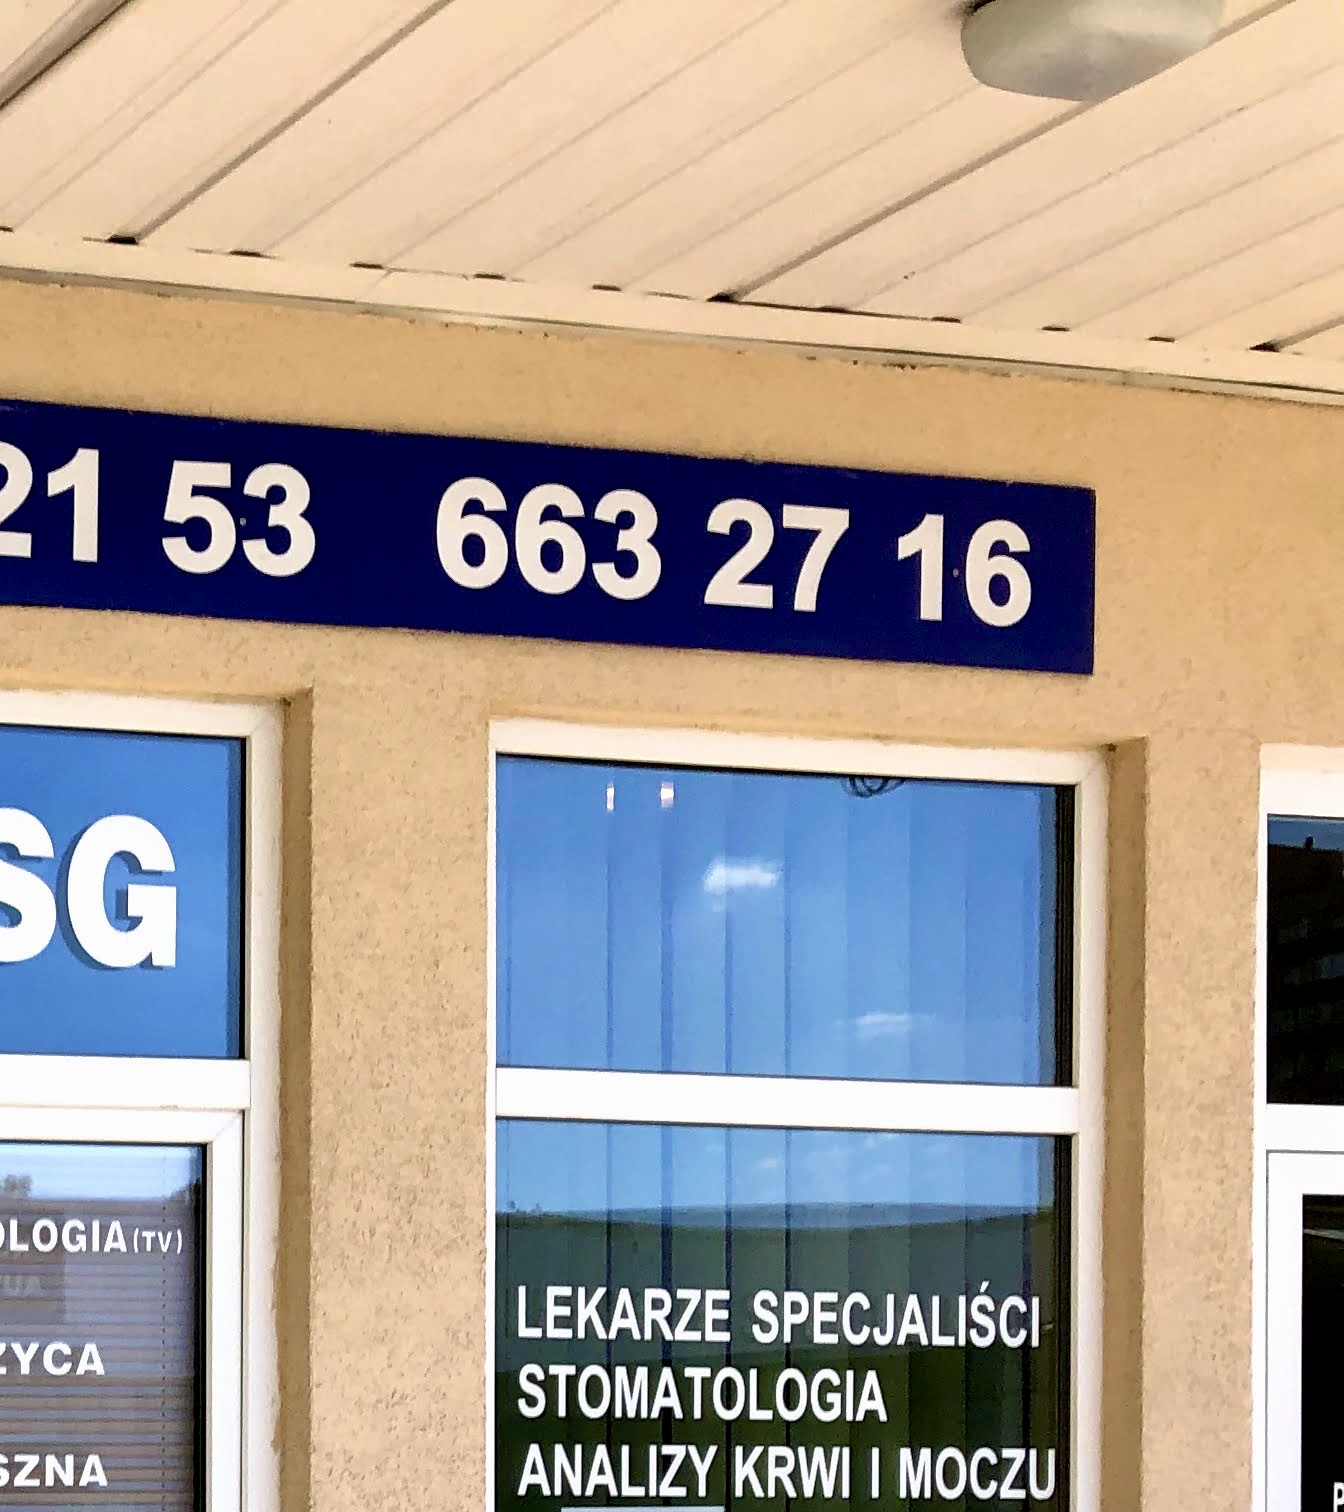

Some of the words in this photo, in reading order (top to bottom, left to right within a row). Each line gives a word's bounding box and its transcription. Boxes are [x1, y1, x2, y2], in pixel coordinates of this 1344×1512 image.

[162, 460, 315, 576] 53
[437, 477, 661, 600] 663
[704, 499, 849, 612] 27
[898, 514, 1031, 626] 16
[134, 1228, 182, 1254] (TV)
[518, 1286, 730, 1342] LEKARZE
[752, 1281, 1039, 1347] SPECJALIŚCI
[518, 1364, 887, 1422] STOMATOLOGIA
[518, 1444, 717, 1497] ANALIZY
[735, 1446, 849, 1498] KRWI
[871, 1446, 880, 1499] I
[900, 1447, 1055, 1499] MOCZU
